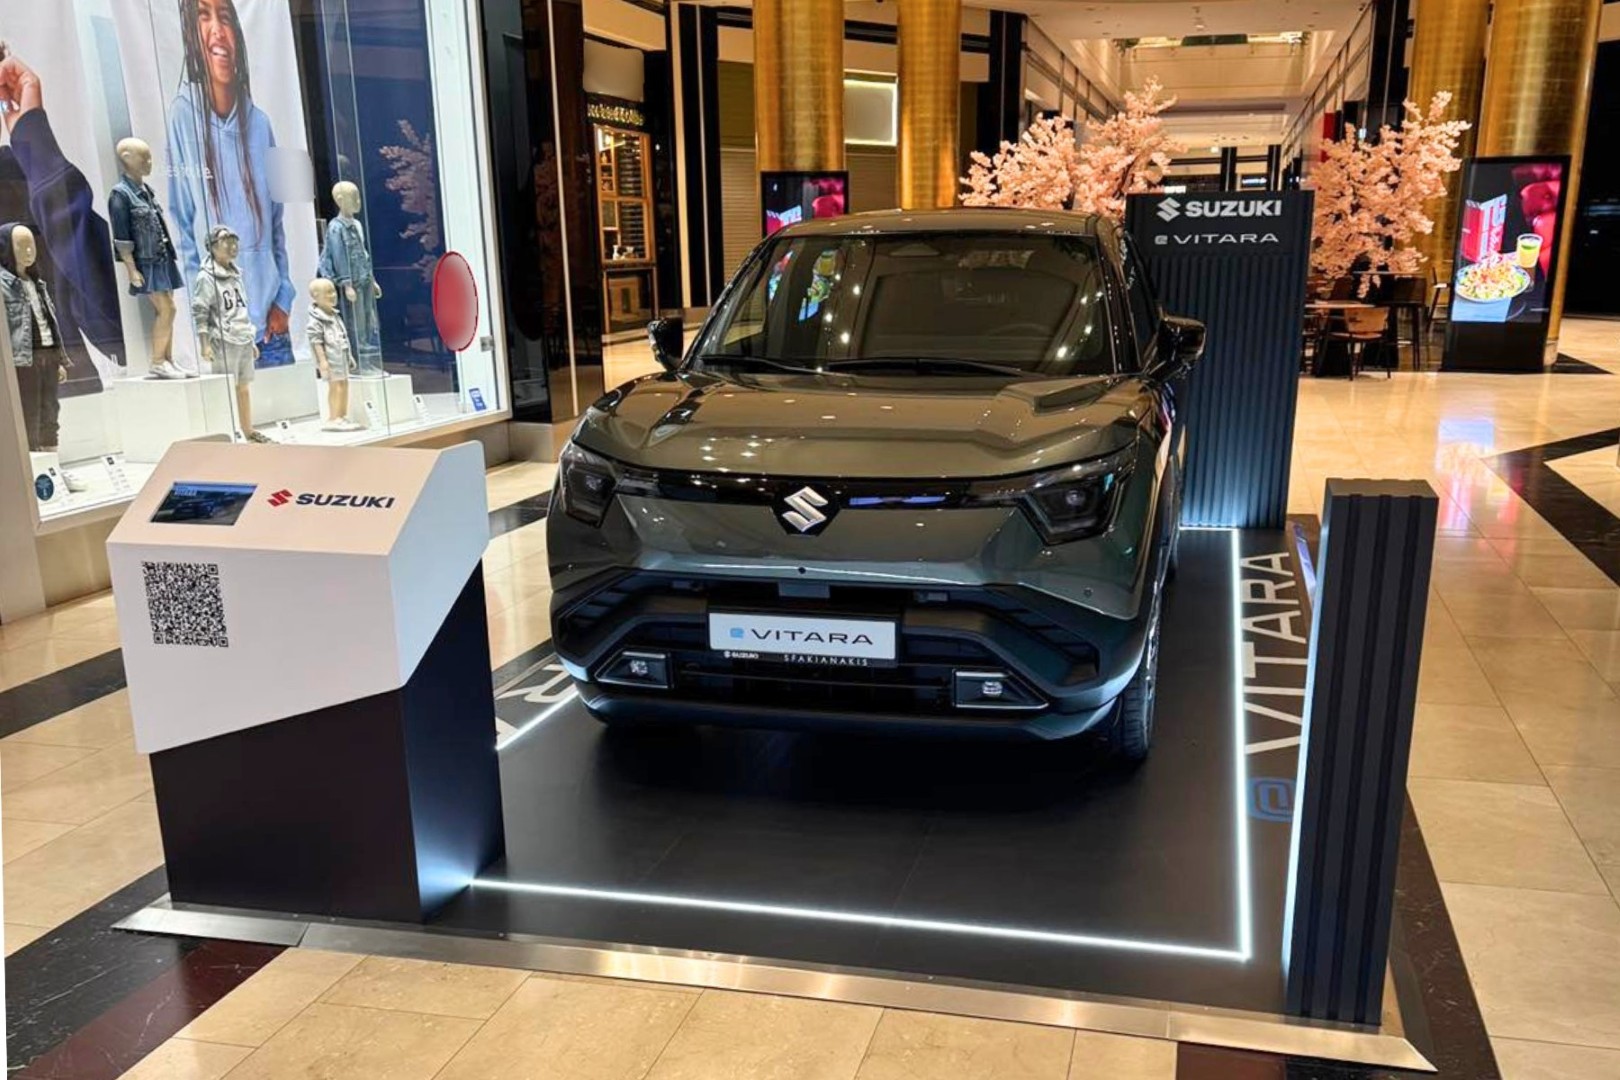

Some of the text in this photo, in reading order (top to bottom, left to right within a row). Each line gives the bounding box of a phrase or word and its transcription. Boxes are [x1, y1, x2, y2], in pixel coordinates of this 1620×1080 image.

[1184, 200, 1282, 218] SUZUKI
[1173, 232, 1279, 245] VITARA
[295, 493, 395, 509] SUZUKI
[751, 628, 874, 646] VITARA
[784, 654, 869, 667] SFAKIANAKIS
[1239, 551, 1309, 755] VITARA
